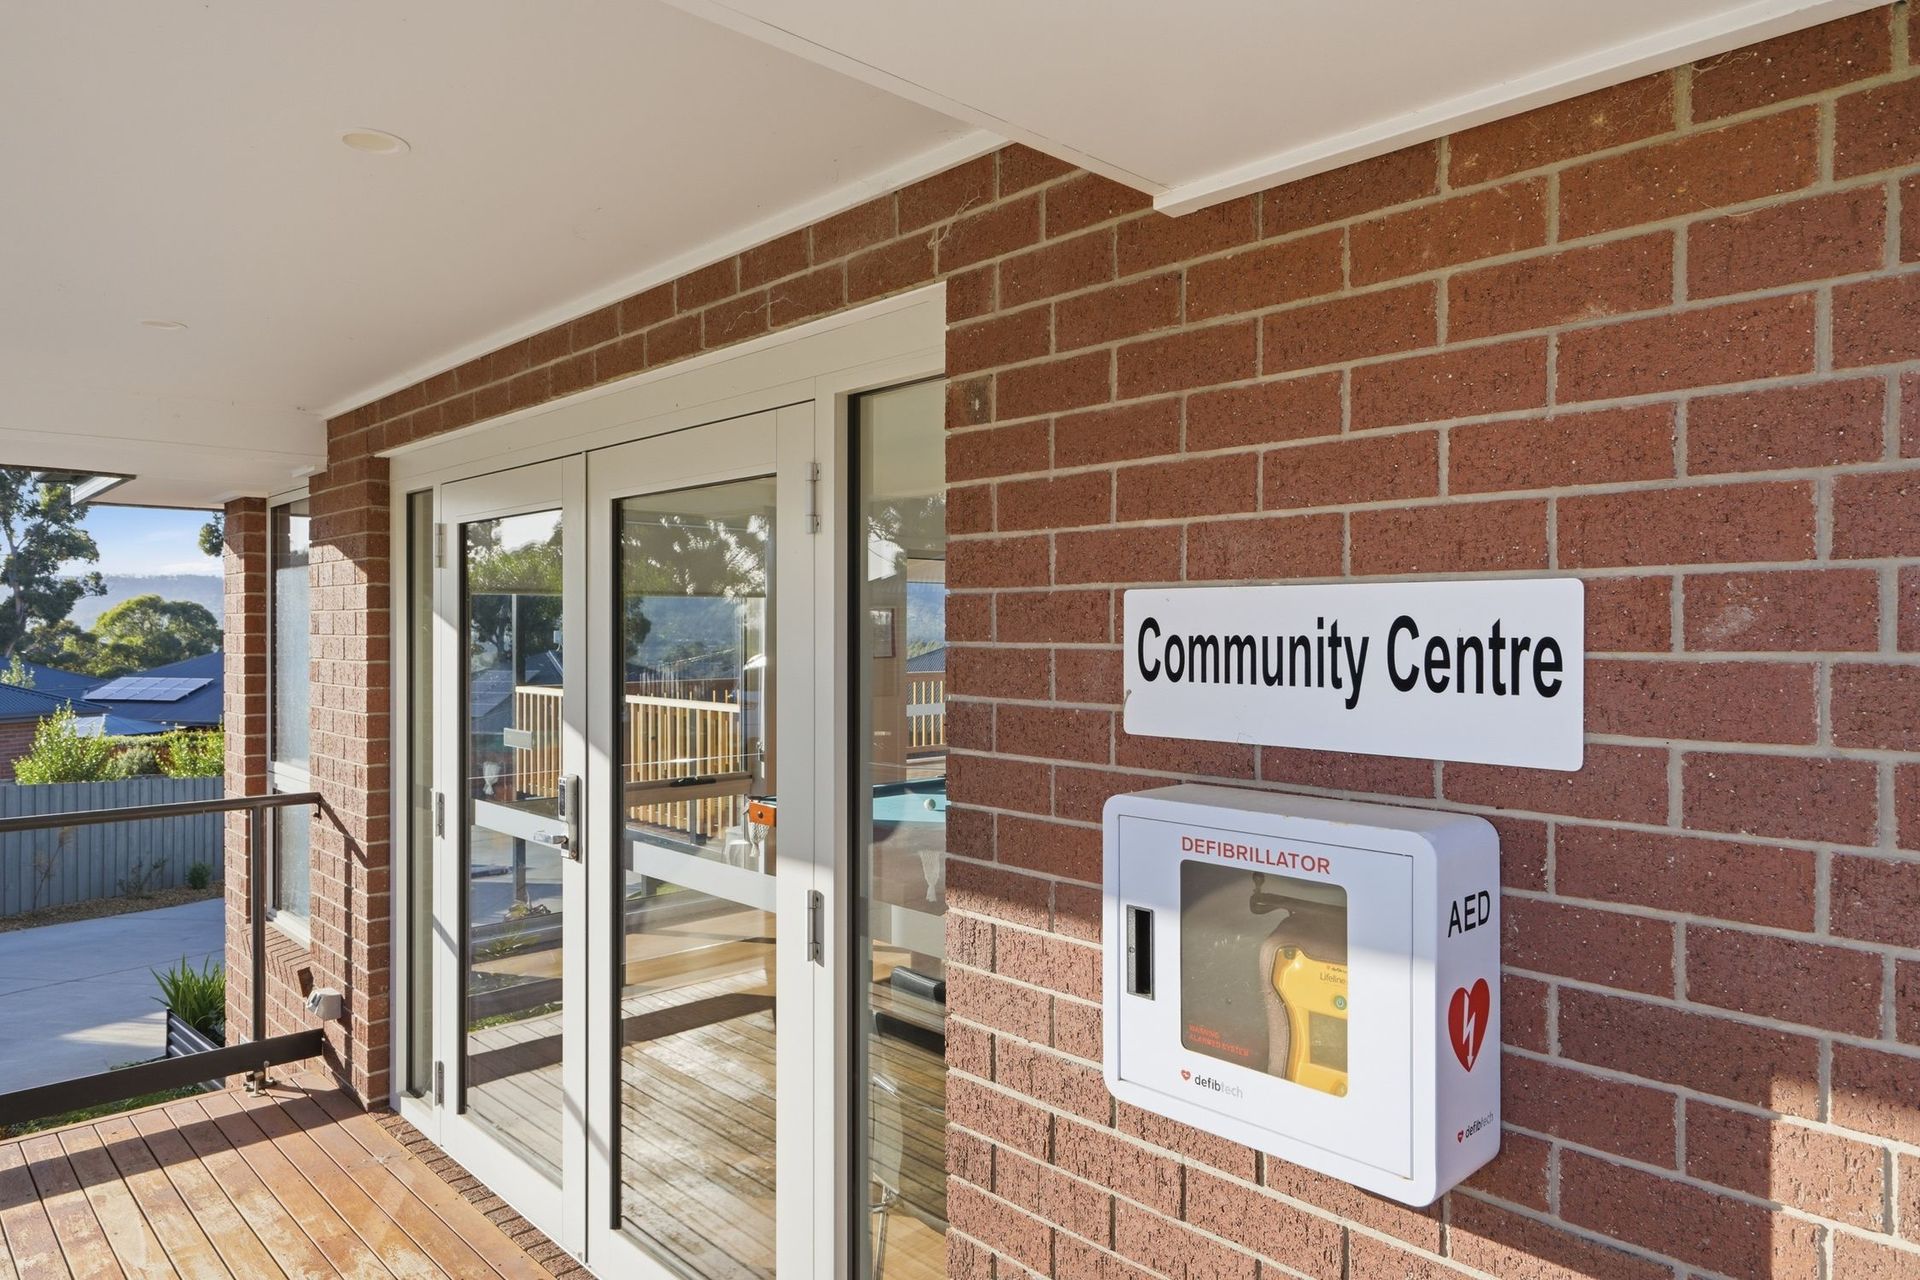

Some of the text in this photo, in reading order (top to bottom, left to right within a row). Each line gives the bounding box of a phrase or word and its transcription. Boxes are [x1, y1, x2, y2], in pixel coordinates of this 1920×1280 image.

[1137, 614, 1564, 710] Community Centre
[1181, 836, 1330, 875] DEFIBRILLATOR
[1447, 889, 1491, 938] AED
[1194, 1074, 1244, 1099] defibtech
[1465, 1111, 1494, 1138] defibtech
